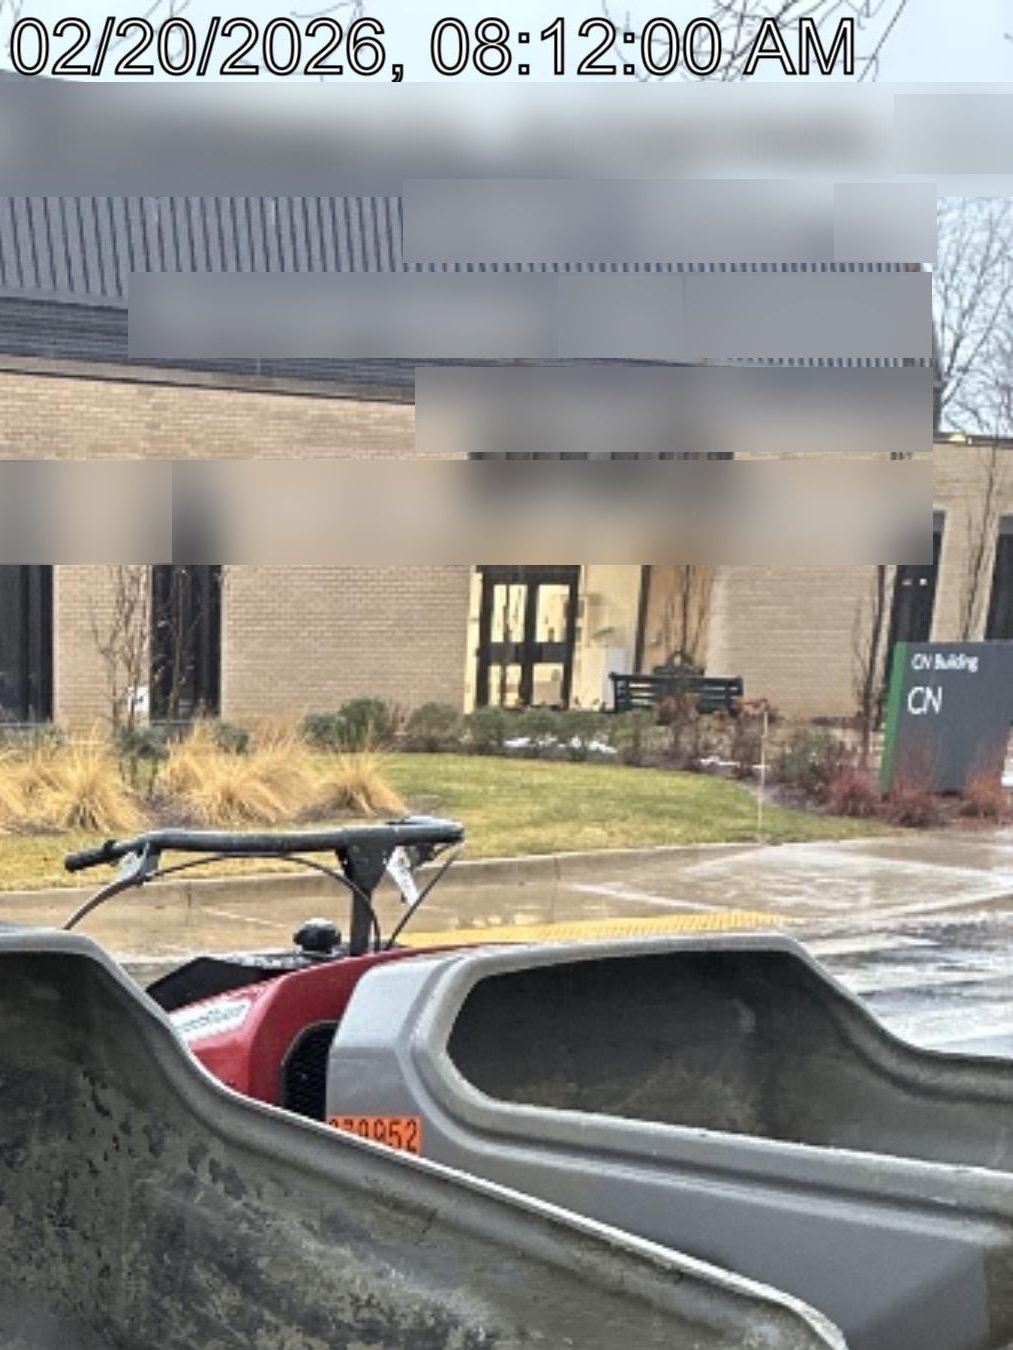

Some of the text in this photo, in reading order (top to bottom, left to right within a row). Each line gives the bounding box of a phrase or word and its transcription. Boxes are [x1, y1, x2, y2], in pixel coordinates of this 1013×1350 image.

[911, 653, 978, 672] CN Building
[907, 686, 942, 714] CN
